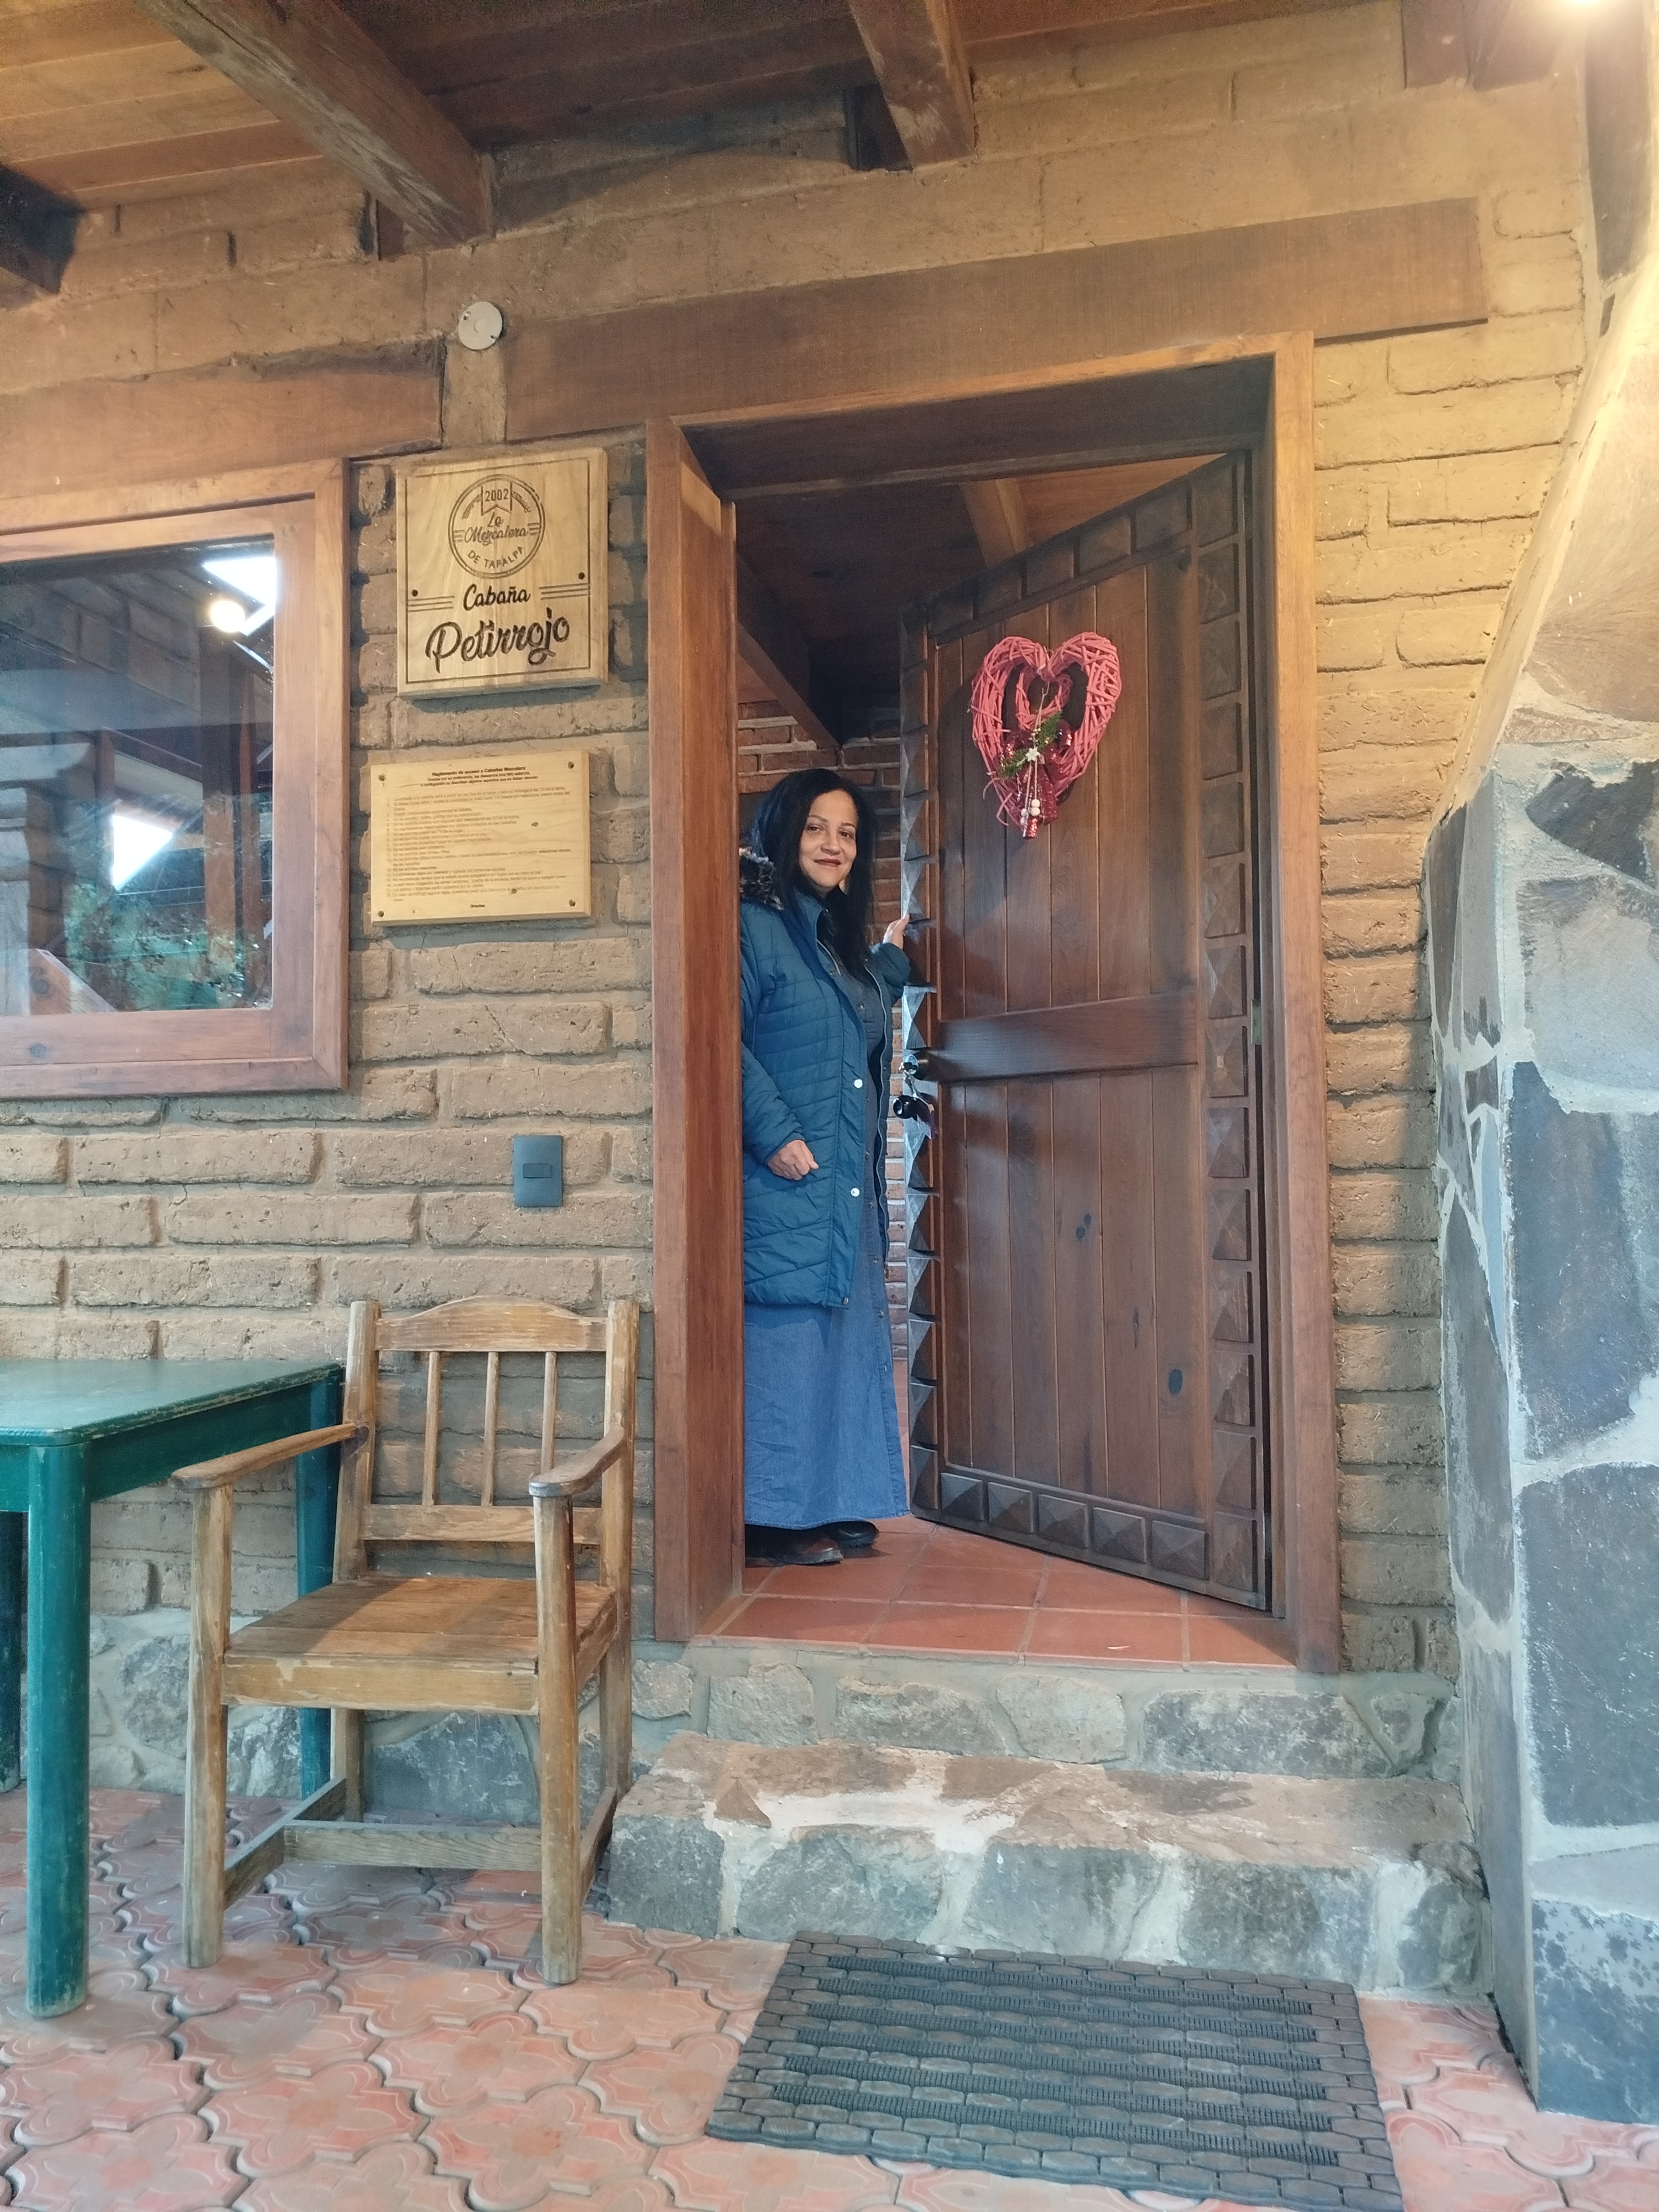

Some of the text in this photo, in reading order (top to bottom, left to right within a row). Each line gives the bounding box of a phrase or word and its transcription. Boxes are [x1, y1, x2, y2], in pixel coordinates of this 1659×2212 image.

[485, 488, 509, 502] 2002
[488, 512, 504, 528] La
[464, 525, 529, 546] Mezcalera
[468, 550, 481, 564] DE
[463, 583, 531, 611] Cabaña
[425, 607, 570, 674] Petirrojo
